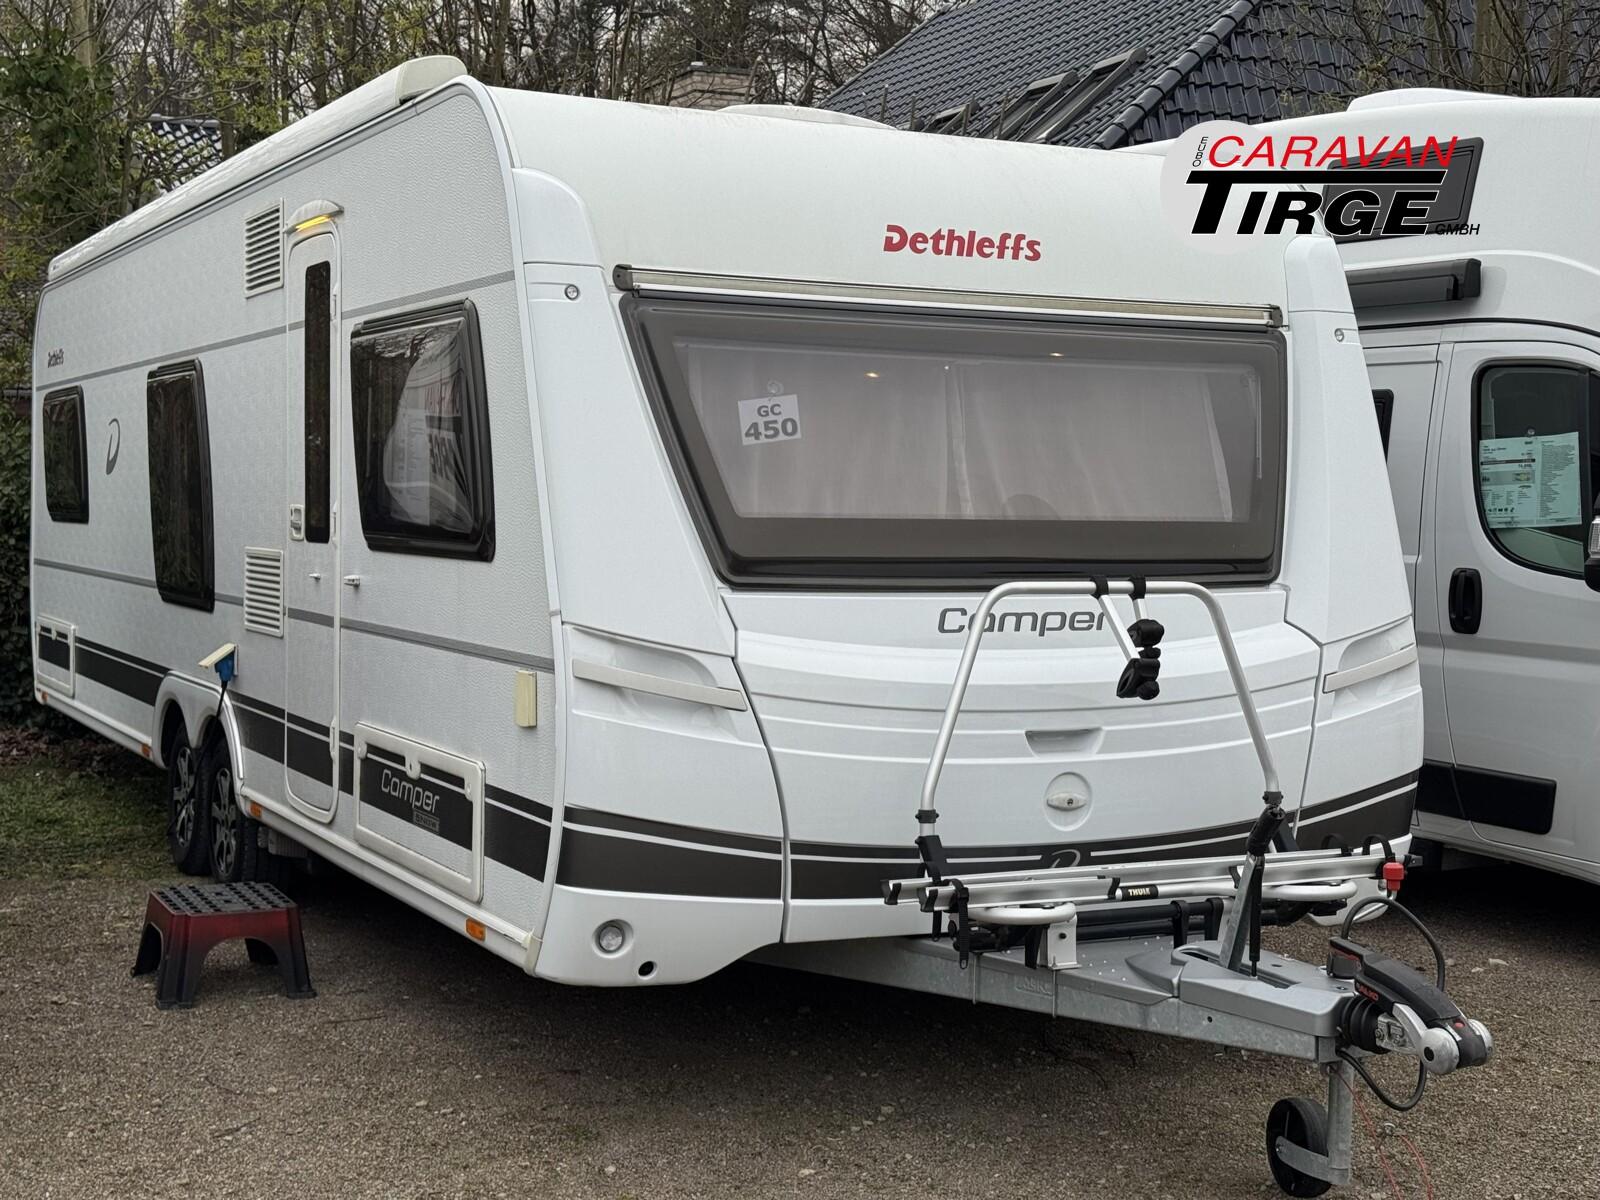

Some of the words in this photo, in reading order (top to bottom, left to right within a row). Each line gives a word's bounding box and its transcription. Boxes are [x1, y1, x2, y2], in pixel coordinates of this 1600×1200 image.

[883, 224, 1042, 262] Dethleffs
[757, 403, 782, 418] GC
[744, 417, 799, 441] 450
[381, 768, 440, 813] Camper
